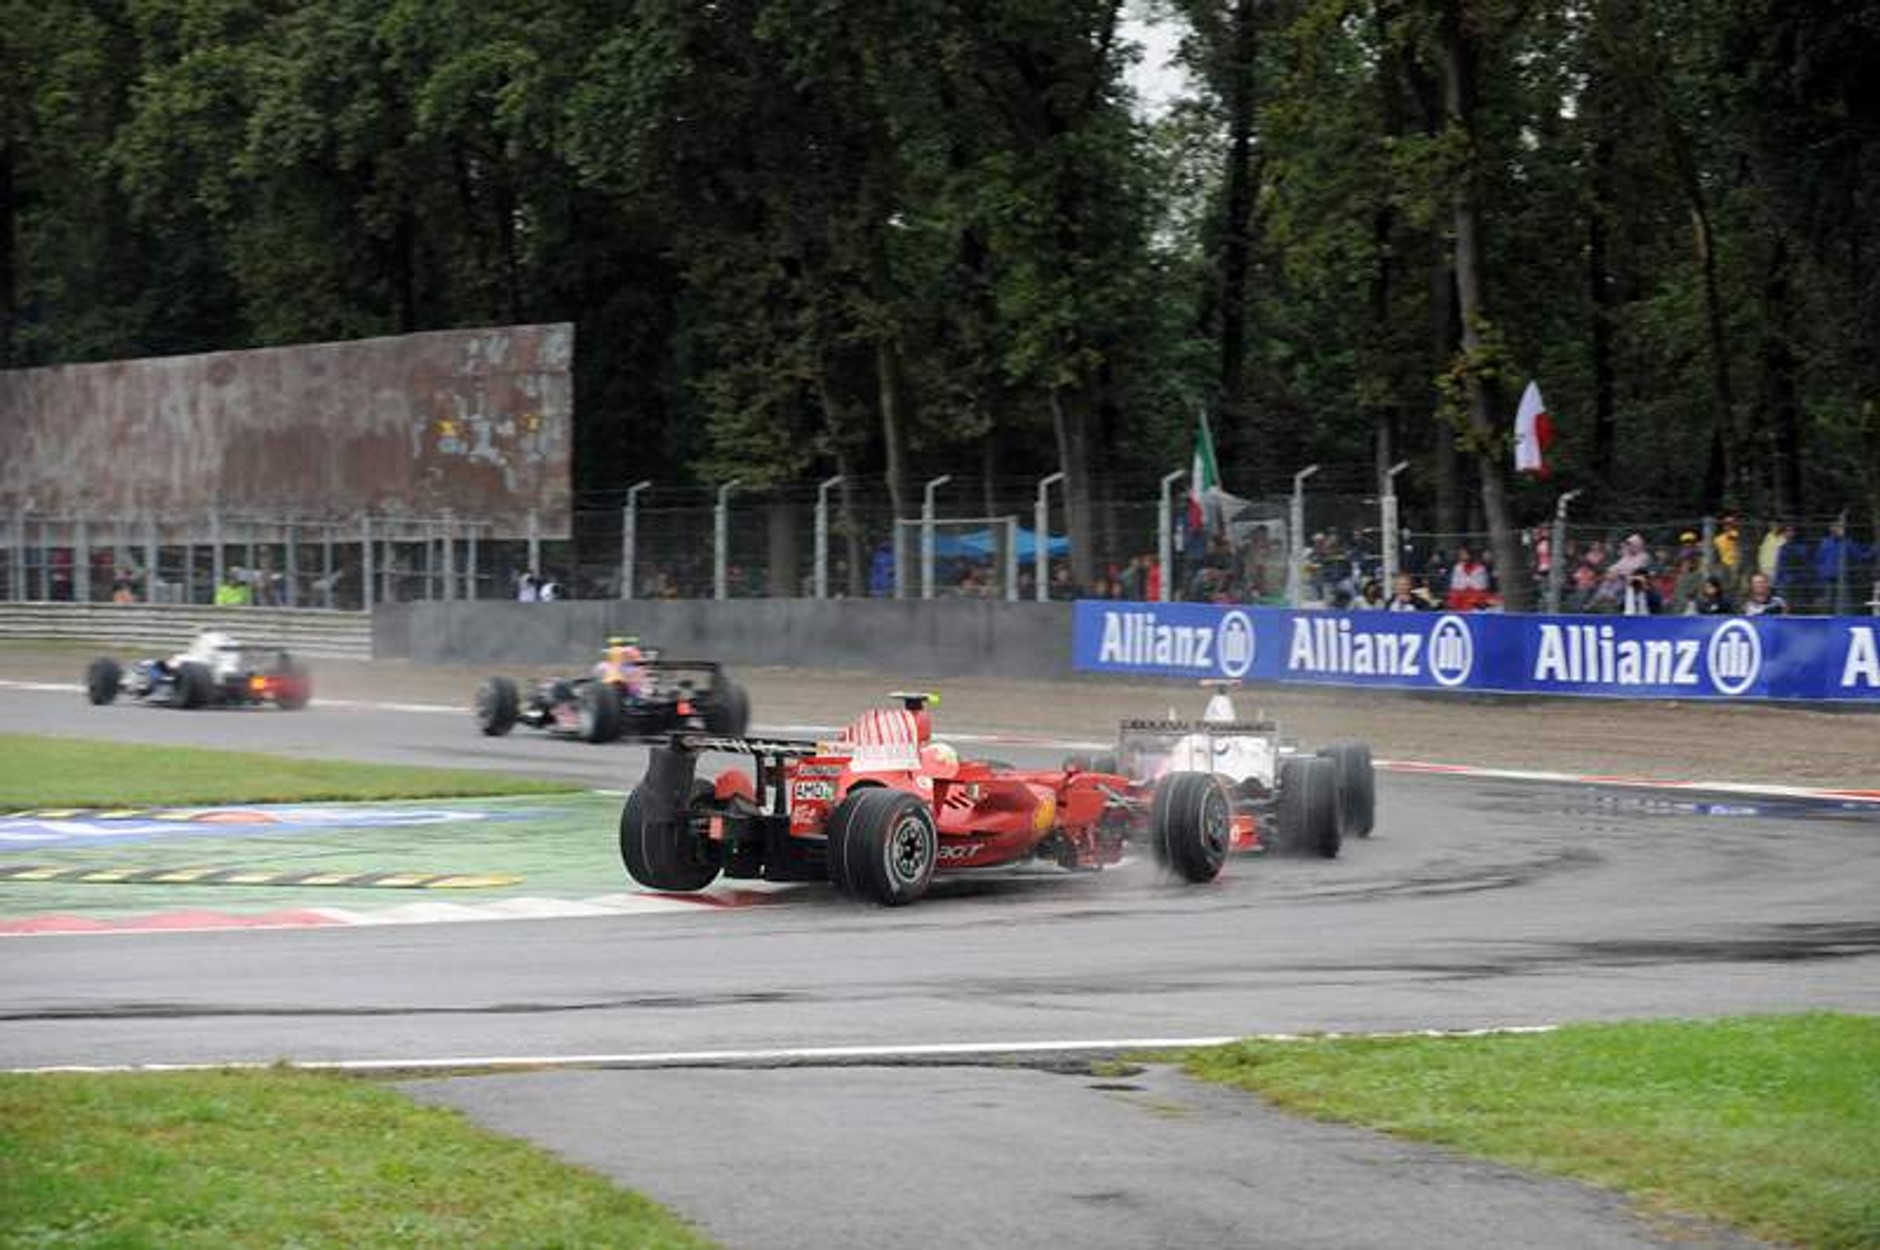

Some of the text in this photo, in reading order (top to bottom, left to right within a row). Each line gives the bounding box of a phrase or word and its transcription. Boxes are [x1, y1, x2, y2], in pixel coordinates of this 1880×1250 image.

[1099, 612, 1213, 667] Allianz
[1288, 617, 1422, 676] Allianz
[1534, 624, 1700, 685] Allianz
